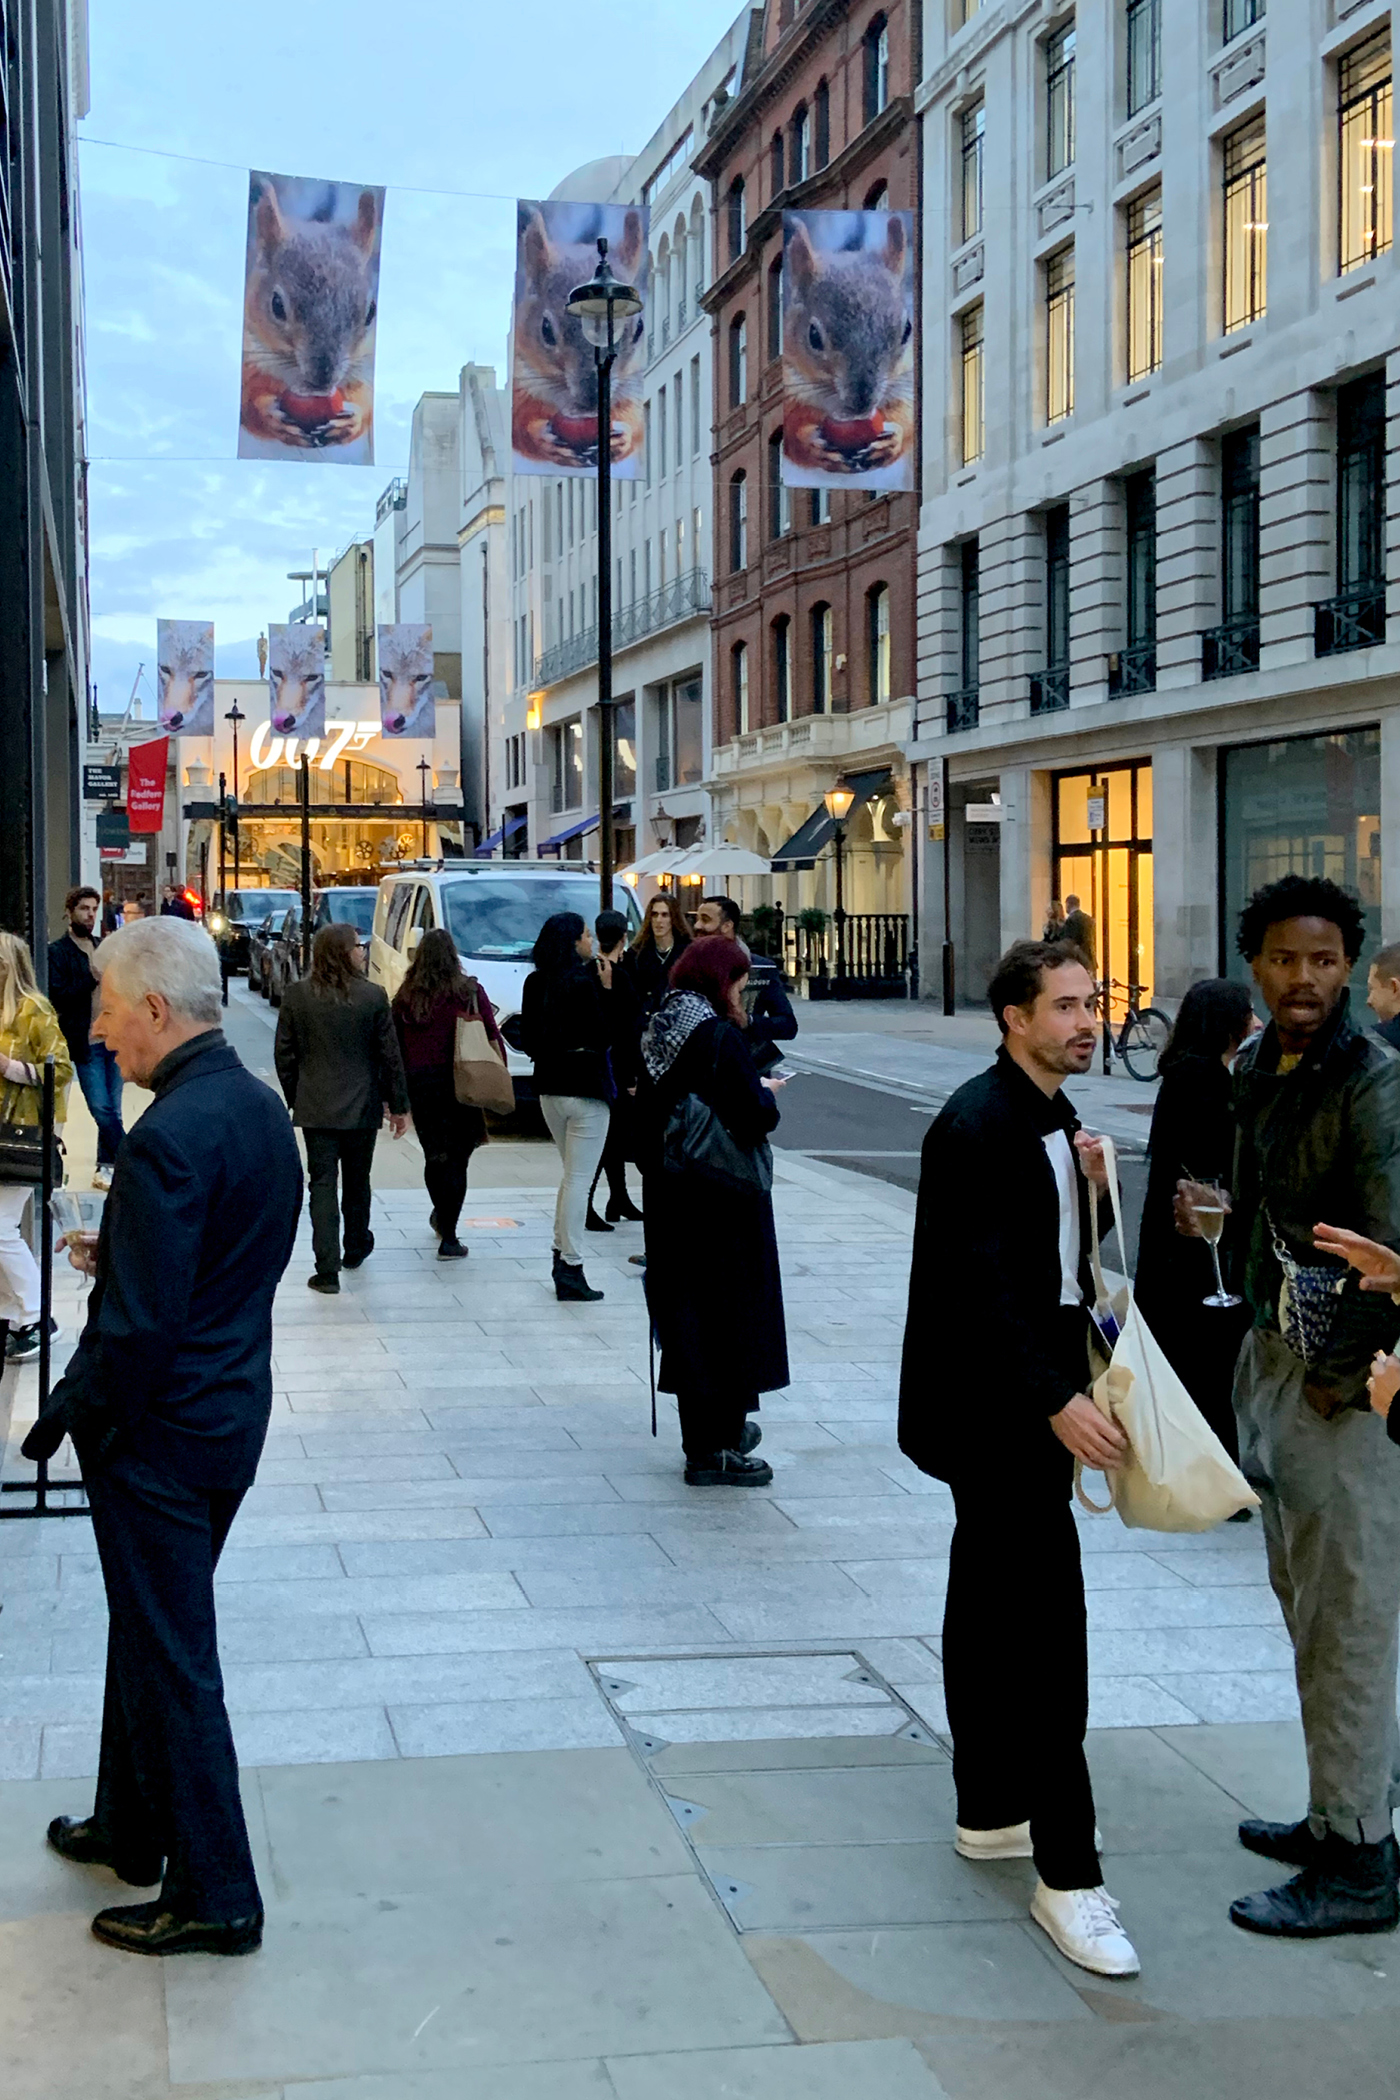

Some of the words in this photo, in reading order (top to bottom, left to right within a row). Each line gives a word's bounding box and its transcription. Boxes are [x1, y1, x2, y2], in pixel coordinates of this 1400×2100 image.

[139, 778, 156, 787] The
[130, 789, 162, 799] Redfern
[131, 801, 161, 812] Gallery
